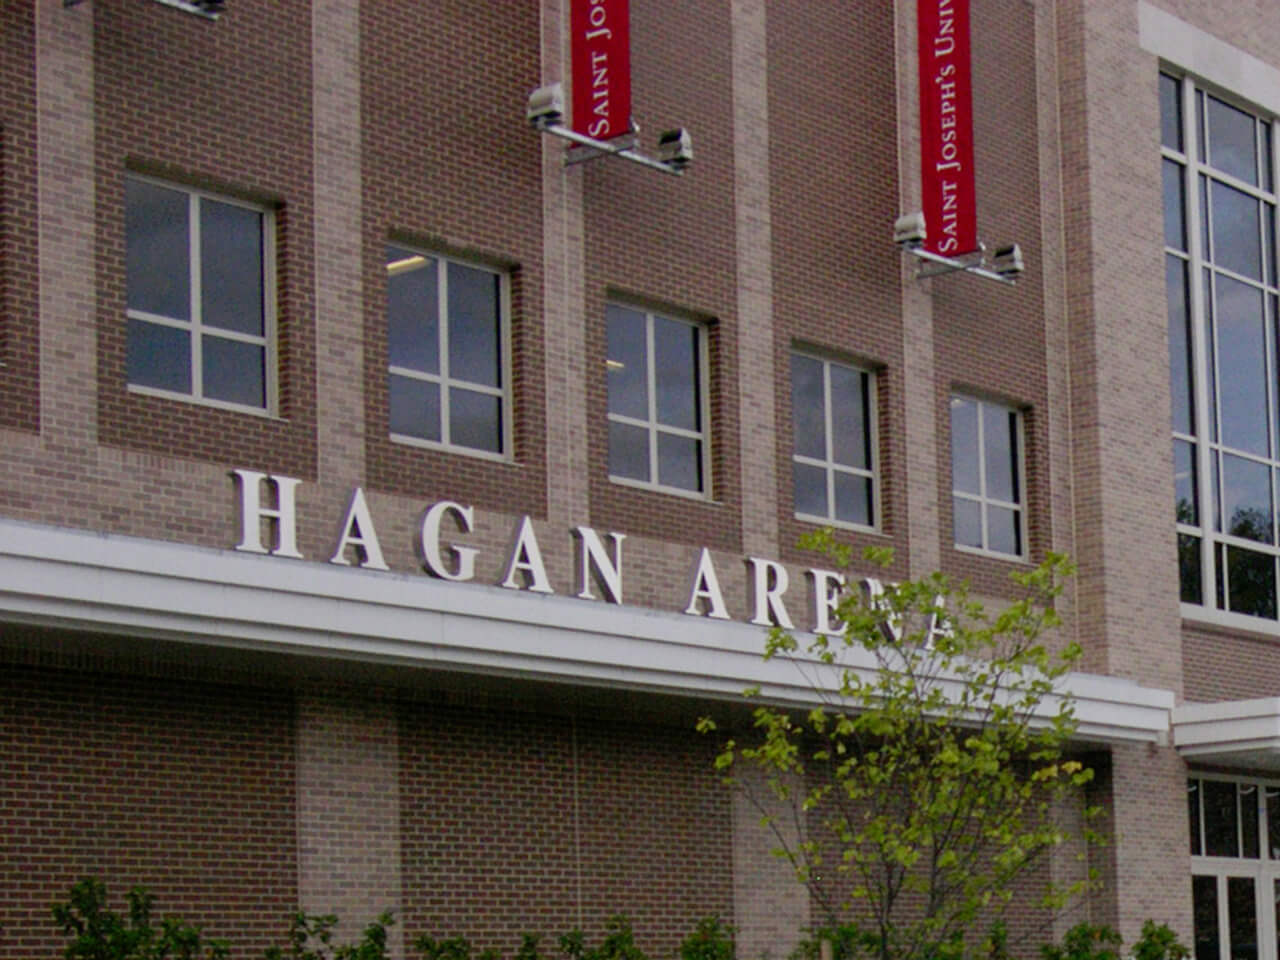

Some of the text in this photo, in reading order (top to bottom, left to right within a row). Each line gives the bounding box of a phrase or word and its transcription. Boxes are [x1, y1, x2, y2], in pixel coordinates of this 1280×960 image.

[588, 51, 609, 137] SAINT
[935, 64, 961, 171] JOSEPH'S
[938, 180, 958, 253] SAINT
[233, 468, 956, 651] HAGAN ARENA
